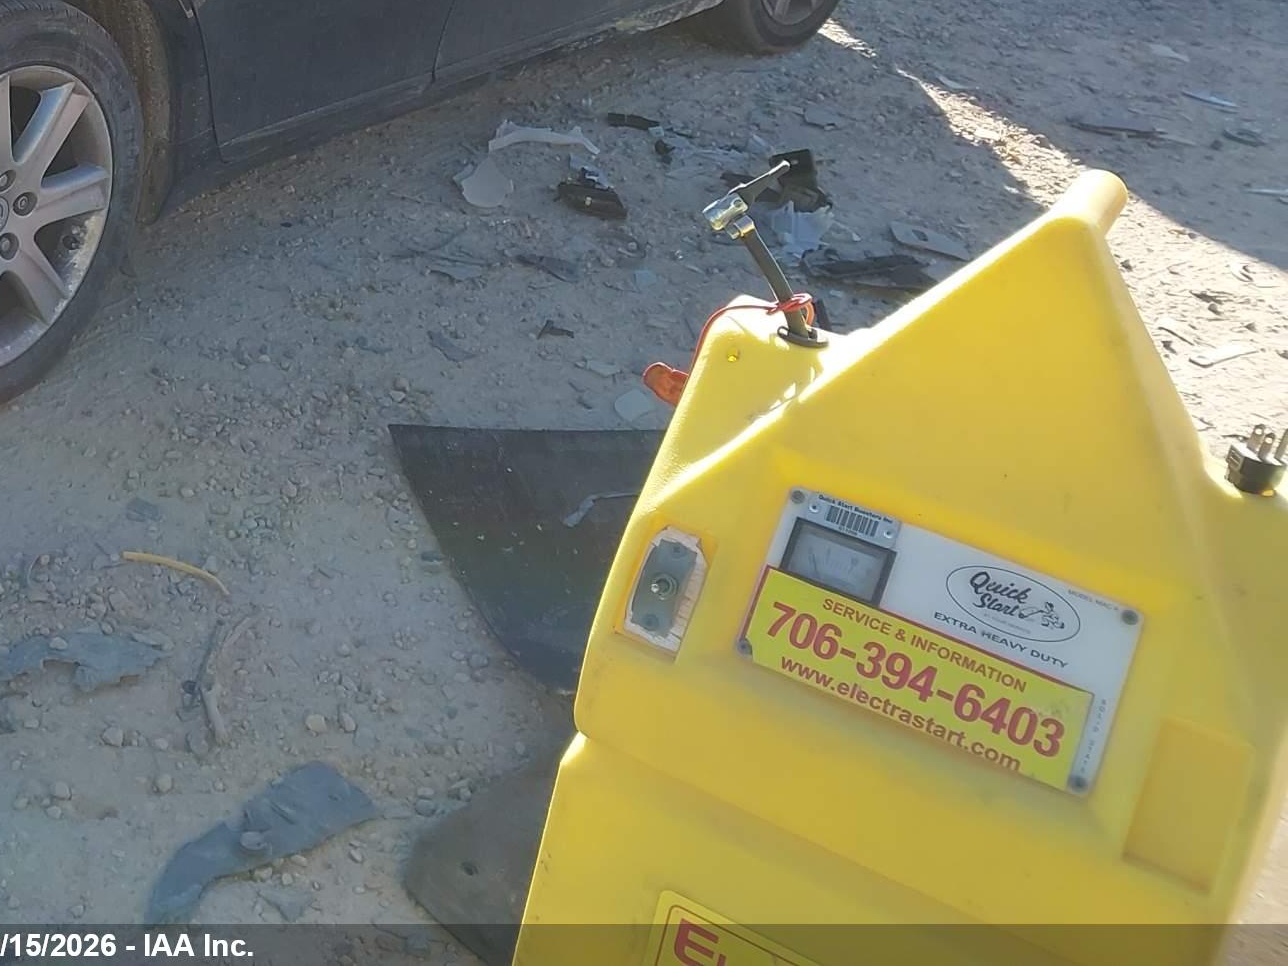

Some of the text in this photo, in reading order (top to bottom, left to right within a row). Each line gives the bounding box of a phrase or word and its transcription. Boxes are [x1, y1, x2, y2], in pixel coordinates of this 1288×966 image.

[969, 571, 1032, 605] Quick
[972, 592, 1021, 617] Start
[822, 597, 1028, 693] SERVICE & INFORMATION
[934, 611, 977, 635] EXTRA
[981, 628, 1027, 653] HEAVY
[1030, 649, 1069, 669] DUTY
[766, 600, 1065, 758] 706-394-6403
[780, 656, 1022, 772] www.electrastart.com
